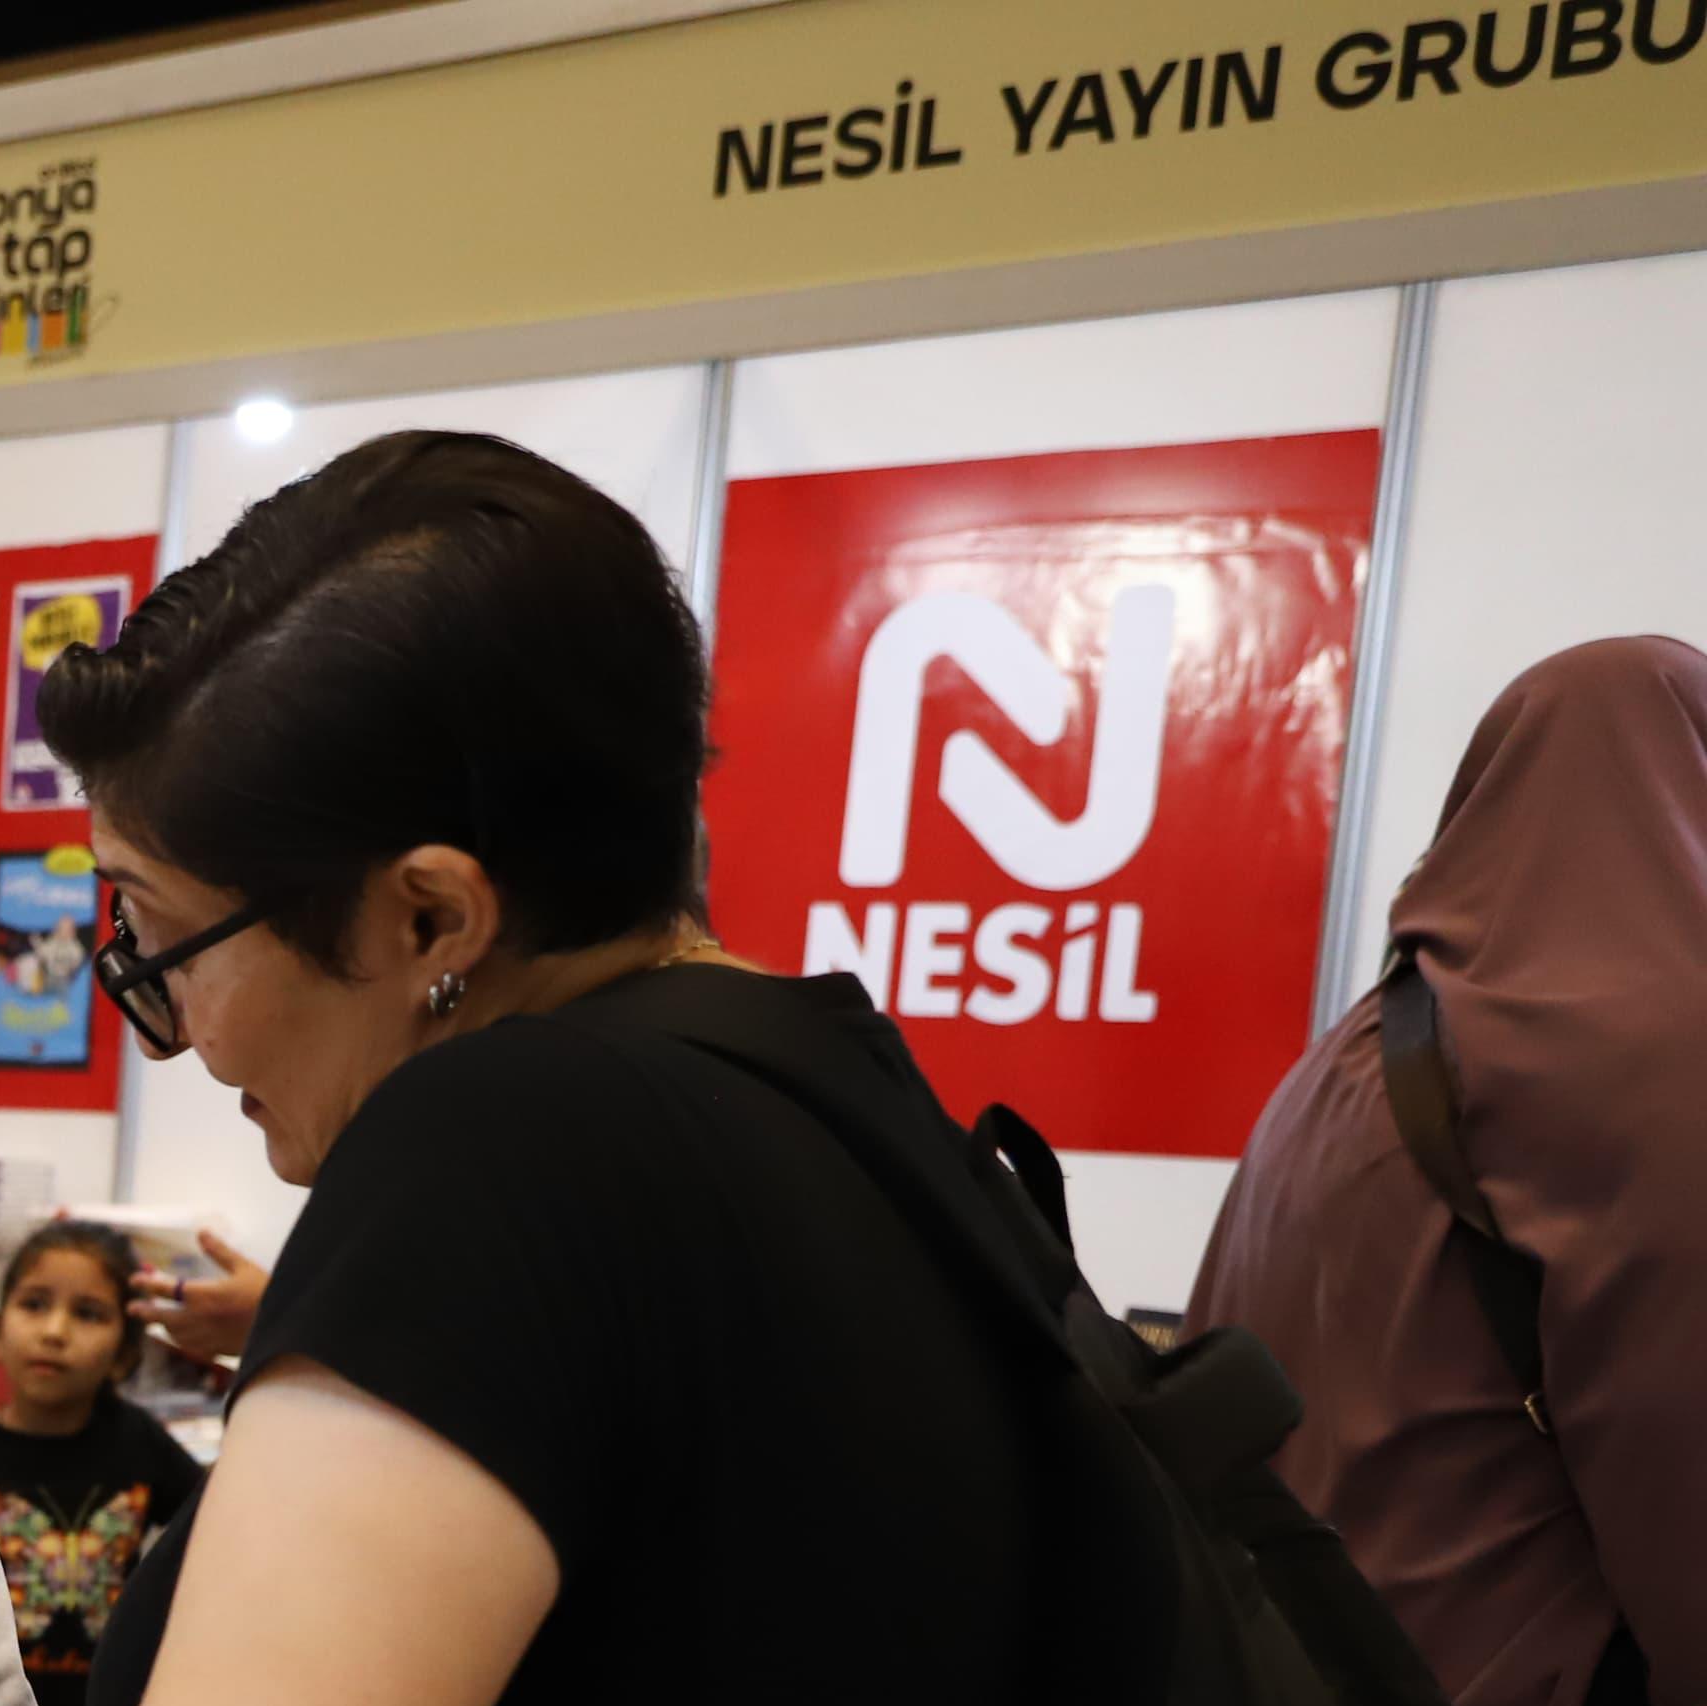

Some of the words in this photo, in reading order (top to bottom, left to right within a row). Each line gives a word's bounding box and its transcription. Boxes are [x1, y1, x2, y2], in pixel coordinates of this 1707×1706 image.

[713, 79, 964, 197] NESİL
[1001, 46, 1283, 155] YAYIN
[1312, 0, 1707, 112] GRUBU
